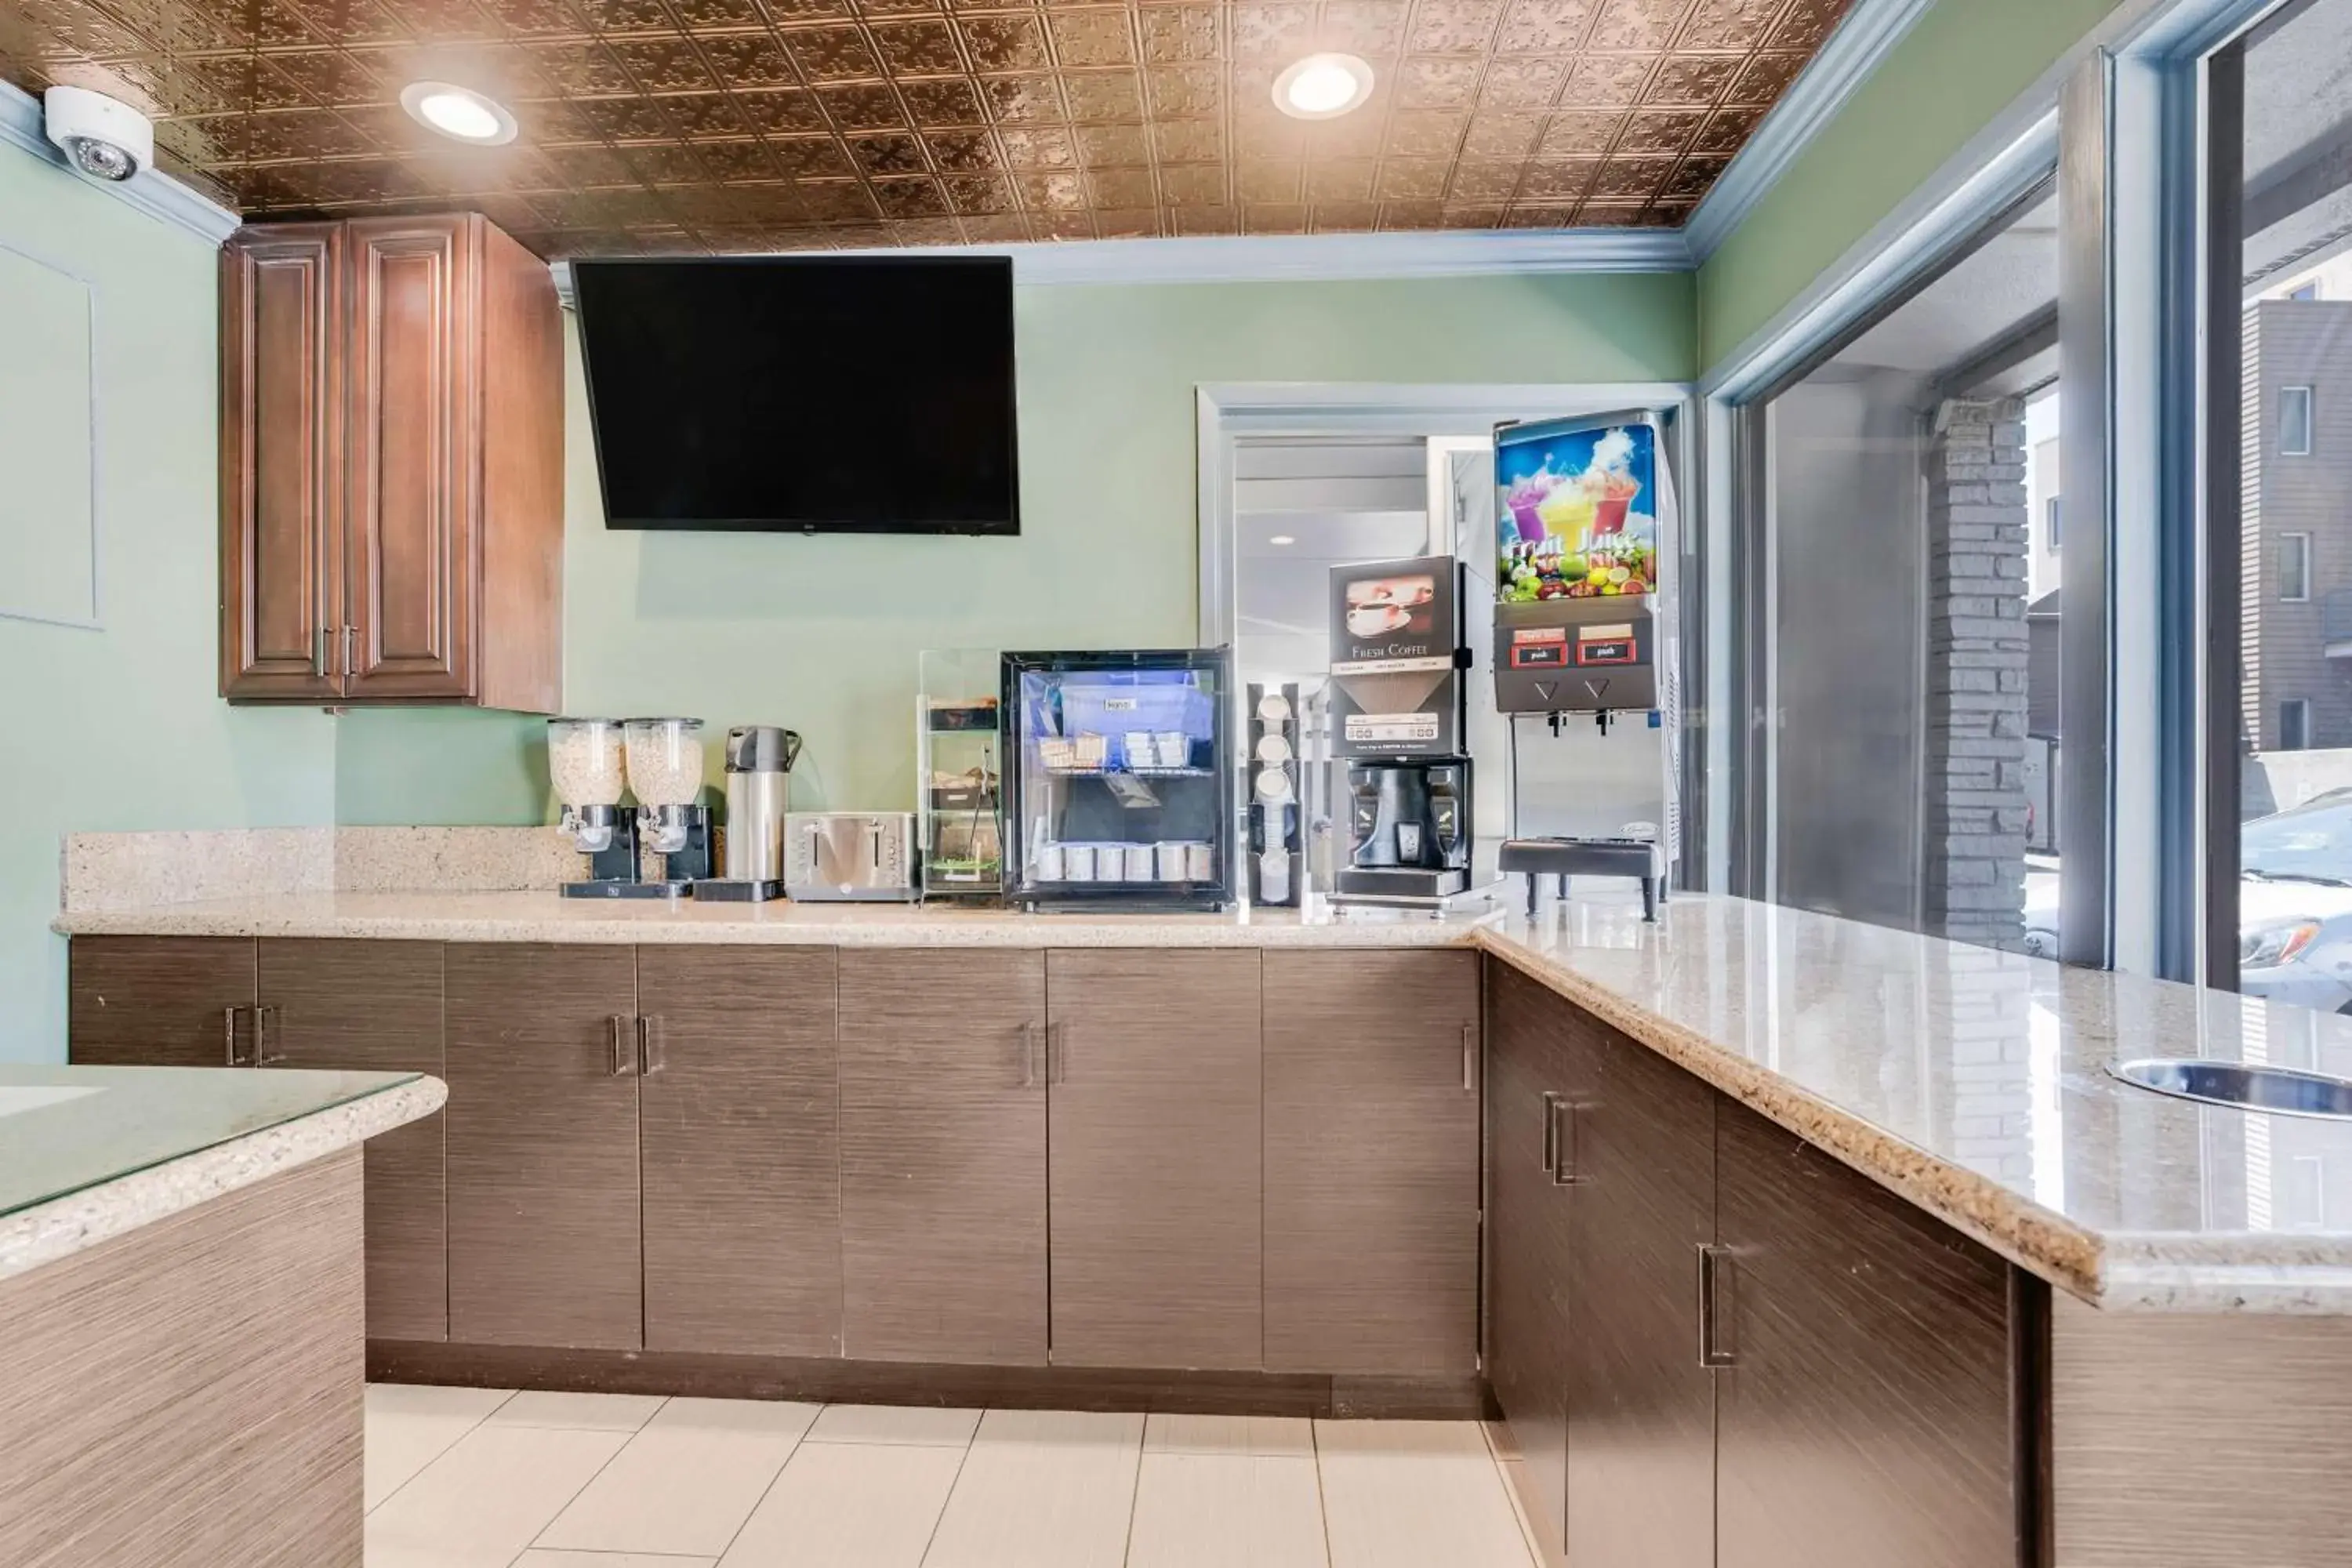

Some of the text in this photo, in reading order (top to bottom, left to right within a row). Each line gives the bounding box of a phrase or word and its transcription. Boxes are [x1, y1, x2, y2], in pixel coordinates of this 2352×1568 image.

[1507, 527, 1635, 557] Fruit Juice
[1352, 644, 1428, 659] FRESH COFFEE
